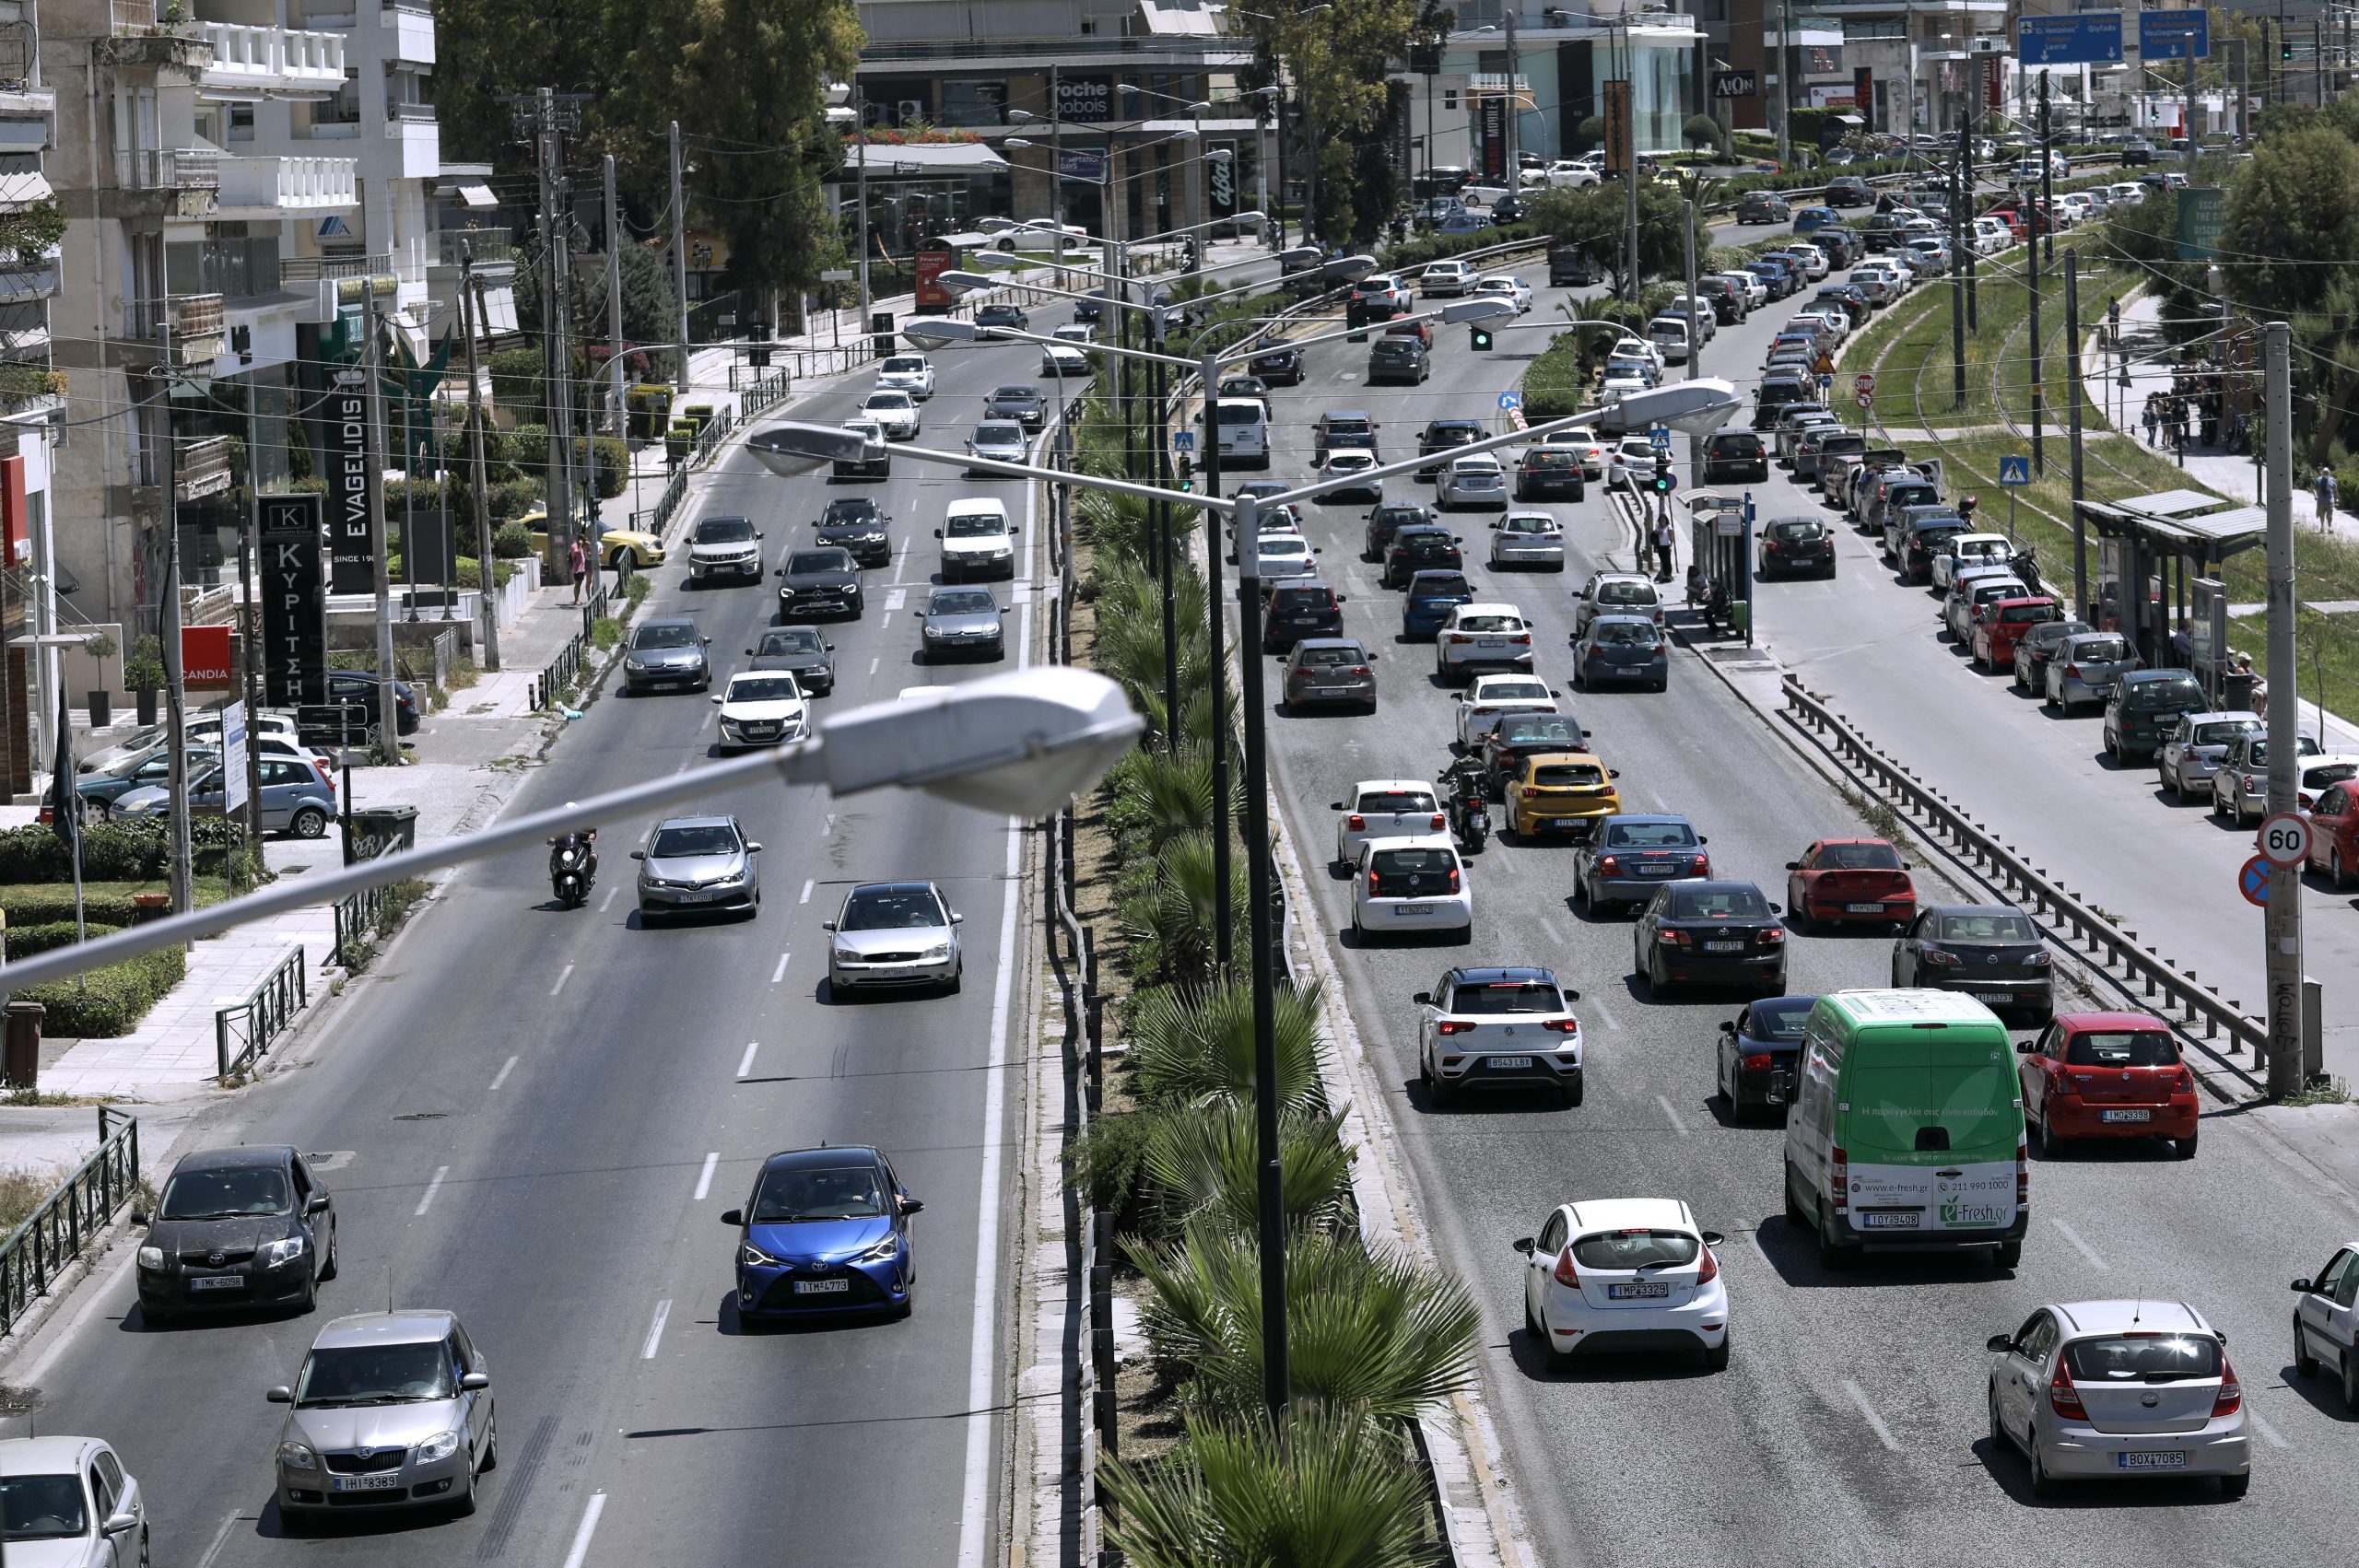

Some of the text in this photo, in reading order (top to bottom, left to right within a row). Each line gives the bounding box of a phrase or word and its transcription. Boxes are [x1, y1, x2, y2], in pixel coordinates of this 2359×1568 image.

[1486, 104, 1500, 137] MOBILE
[2196, 213, 2210, 221] THE
[1856, 379, 1873, 390] STOP
[342, 399, 367, 537] EVAGELIDIS
[334, 555, 359, 563] SINCE
[2269, 829, 2301, 851] 60
[1492, 1059, 1512, 1067] 8543
[1862, 1107, 1870, 1116] Η
[1872, 1107, 1921, 1117] παραγγελία
[1923, 1108, 1940, 1117] σας
[1865, 1184, 1929, 1194] www.e-fresh.gr
[1952, 1180, 2009, 1191] 211 990 1000
